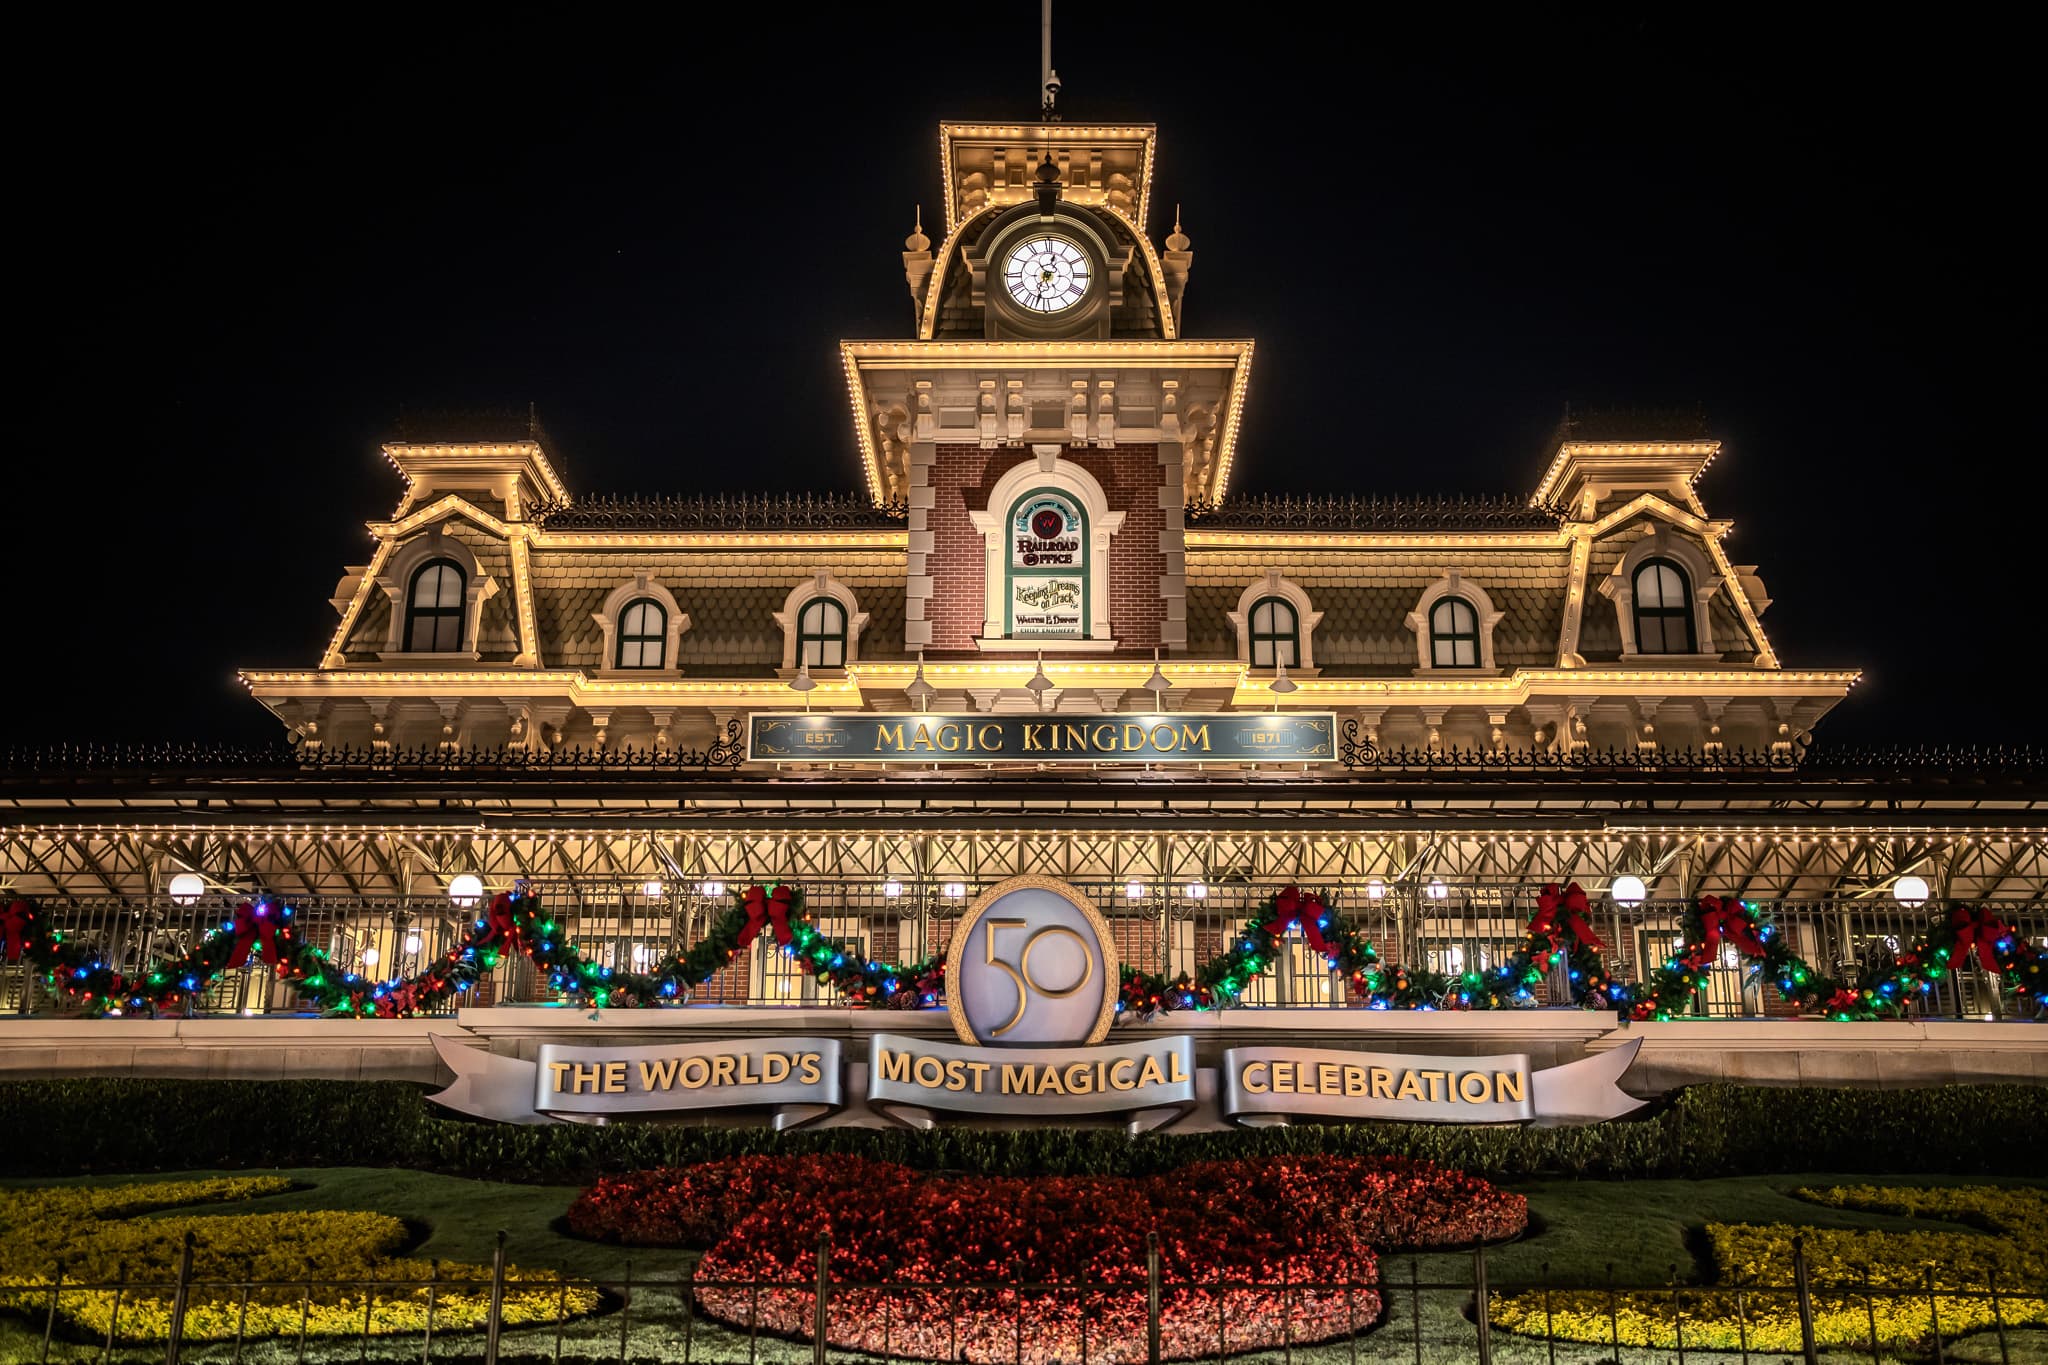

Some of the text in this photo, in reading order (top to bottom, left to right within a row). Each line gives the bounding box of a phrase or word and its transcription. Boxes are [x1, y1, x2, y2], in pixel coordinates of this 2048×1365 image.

[1017, 540, 1079, 553] RAILROAD
[1023, 553, 1073, 566] OFFICE
[1016, 580, 1080, 606] Keeping Dreams
[1041, 591, 1074, 609] on Track
[805, 732, 838, 744] EST.
[874, 723, 1212, 752] MAGIC KINGDOM
[1252, 732, 1281, 744] 1971
[986, 918, 1093, 1037] 50
[549, 1052, 822, 1095] THE WORLD'S
[877, 1050, 1191, 1097] MOST MAGICAL
[1240, 1061, 1526, 1104] CELEBRATION
